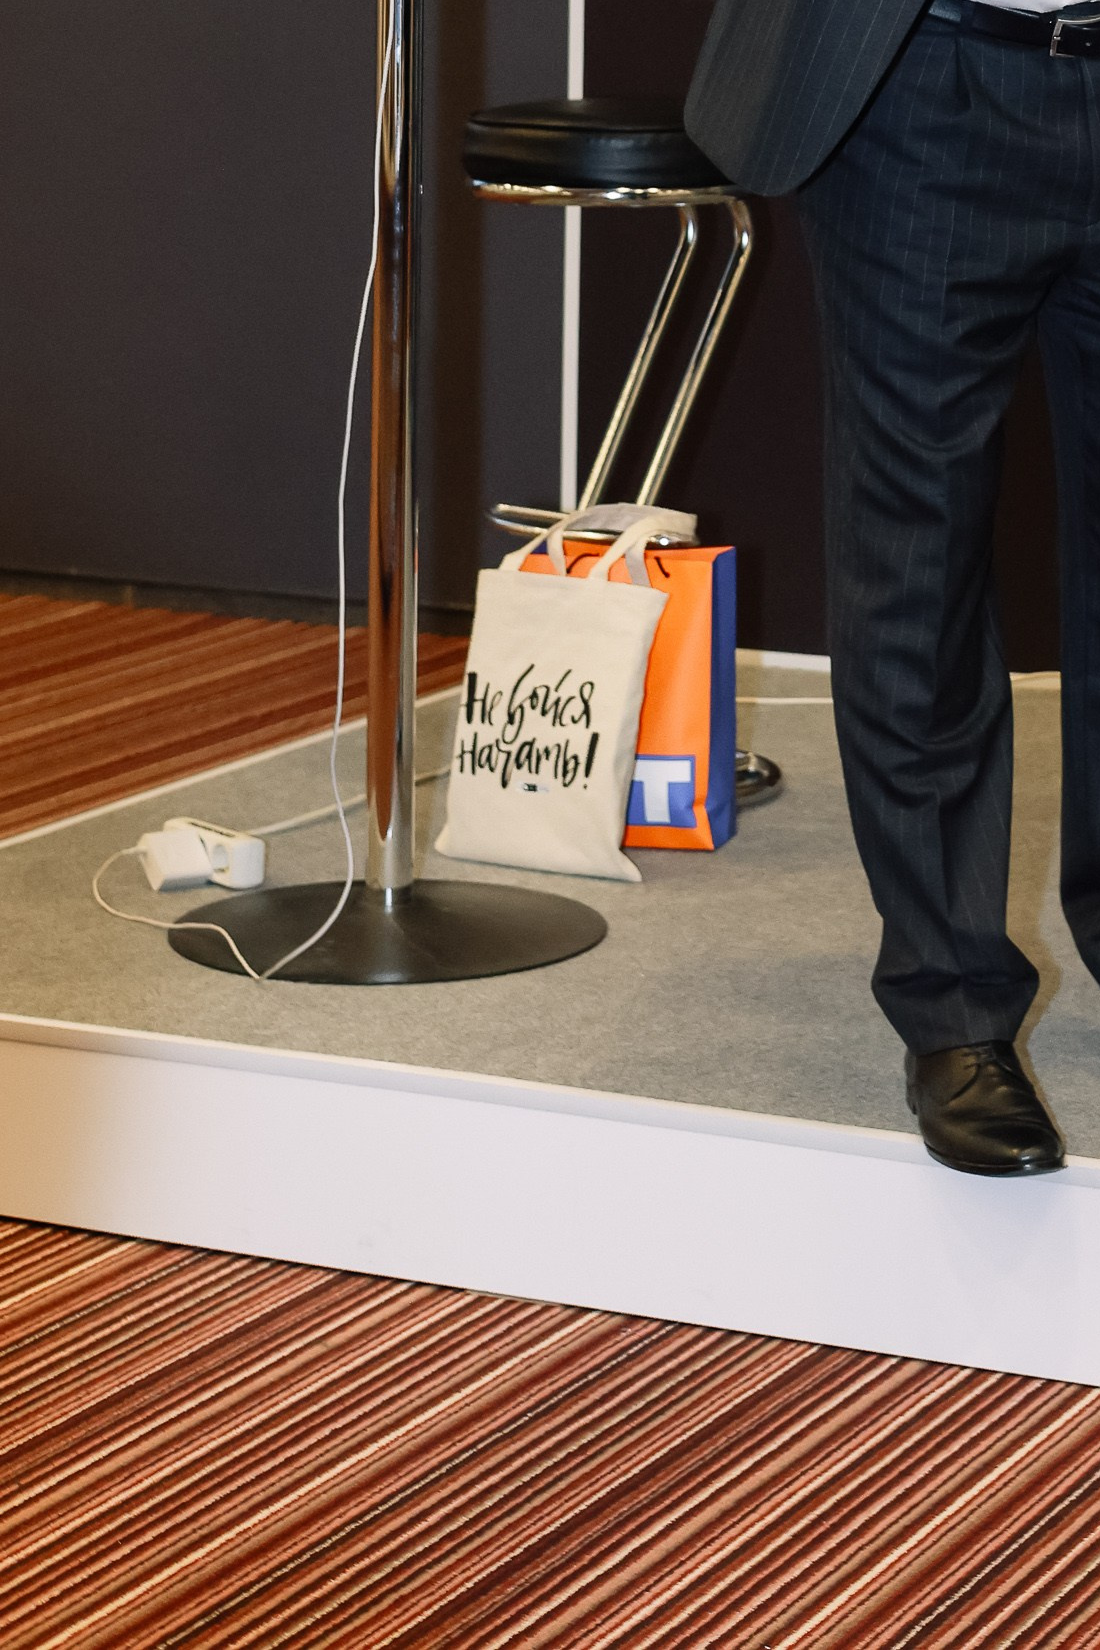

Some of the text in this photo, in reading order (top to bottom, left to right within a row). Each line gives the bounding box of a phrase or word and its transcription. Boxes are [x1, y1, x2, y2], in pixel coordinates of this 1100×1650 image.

[462, 663, 595, 745] Не бойся
[457, 731, 600, 790] Начать!
